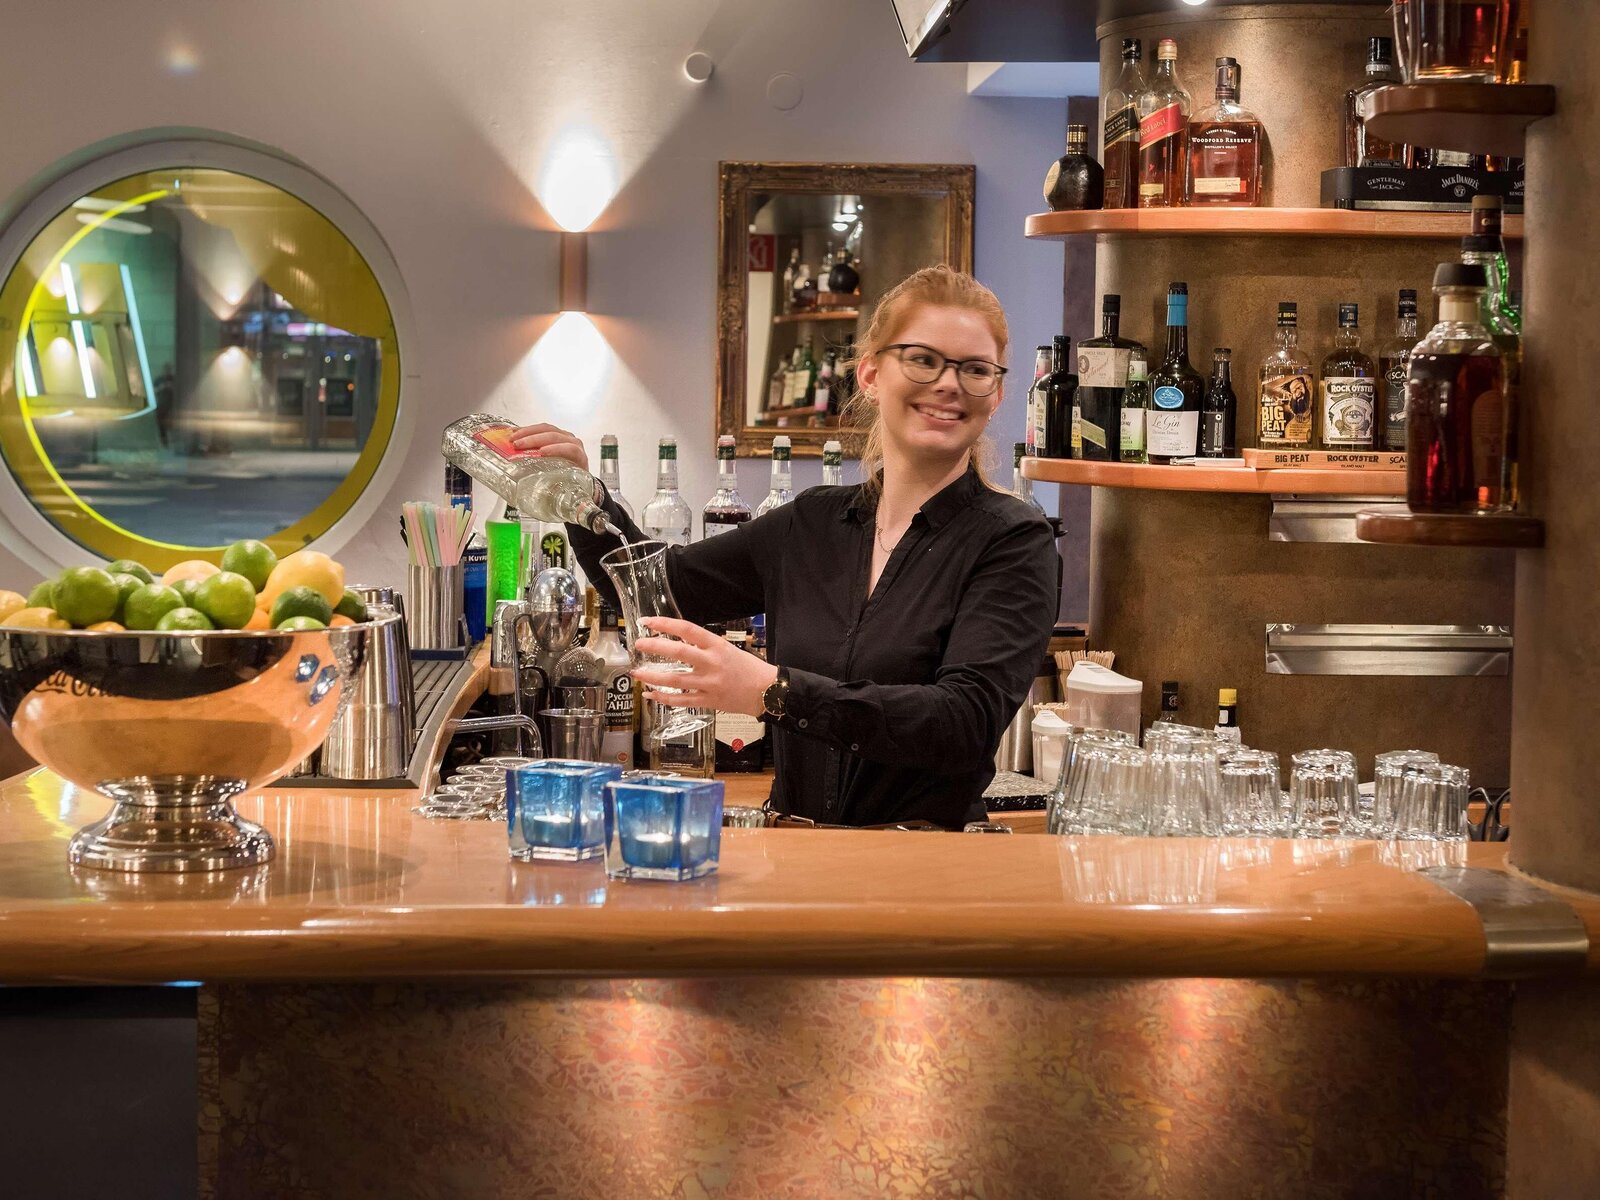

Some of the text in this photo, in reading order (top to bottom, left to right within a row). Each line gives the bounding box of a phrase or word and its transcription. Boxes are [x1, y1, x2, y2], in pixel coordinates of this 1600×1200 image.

[1366, 177, 1406, 187] GENTLEMAN
[1441, 173, 1480, 190] JACK DANIEL'S
[1391, 371, 1407, 380] SCA
[1331, 385, 1350, 393] ROCK
[1261, 405, 1285, 421] BIG
[1152, 413, 1180, 430] Le Gin
[1261, 420, 1287, 432] PEAT
[1275, 454, 1310, 463] BIG PEAT
[1326, 454, 1379, 464] ROCK OYSTER
